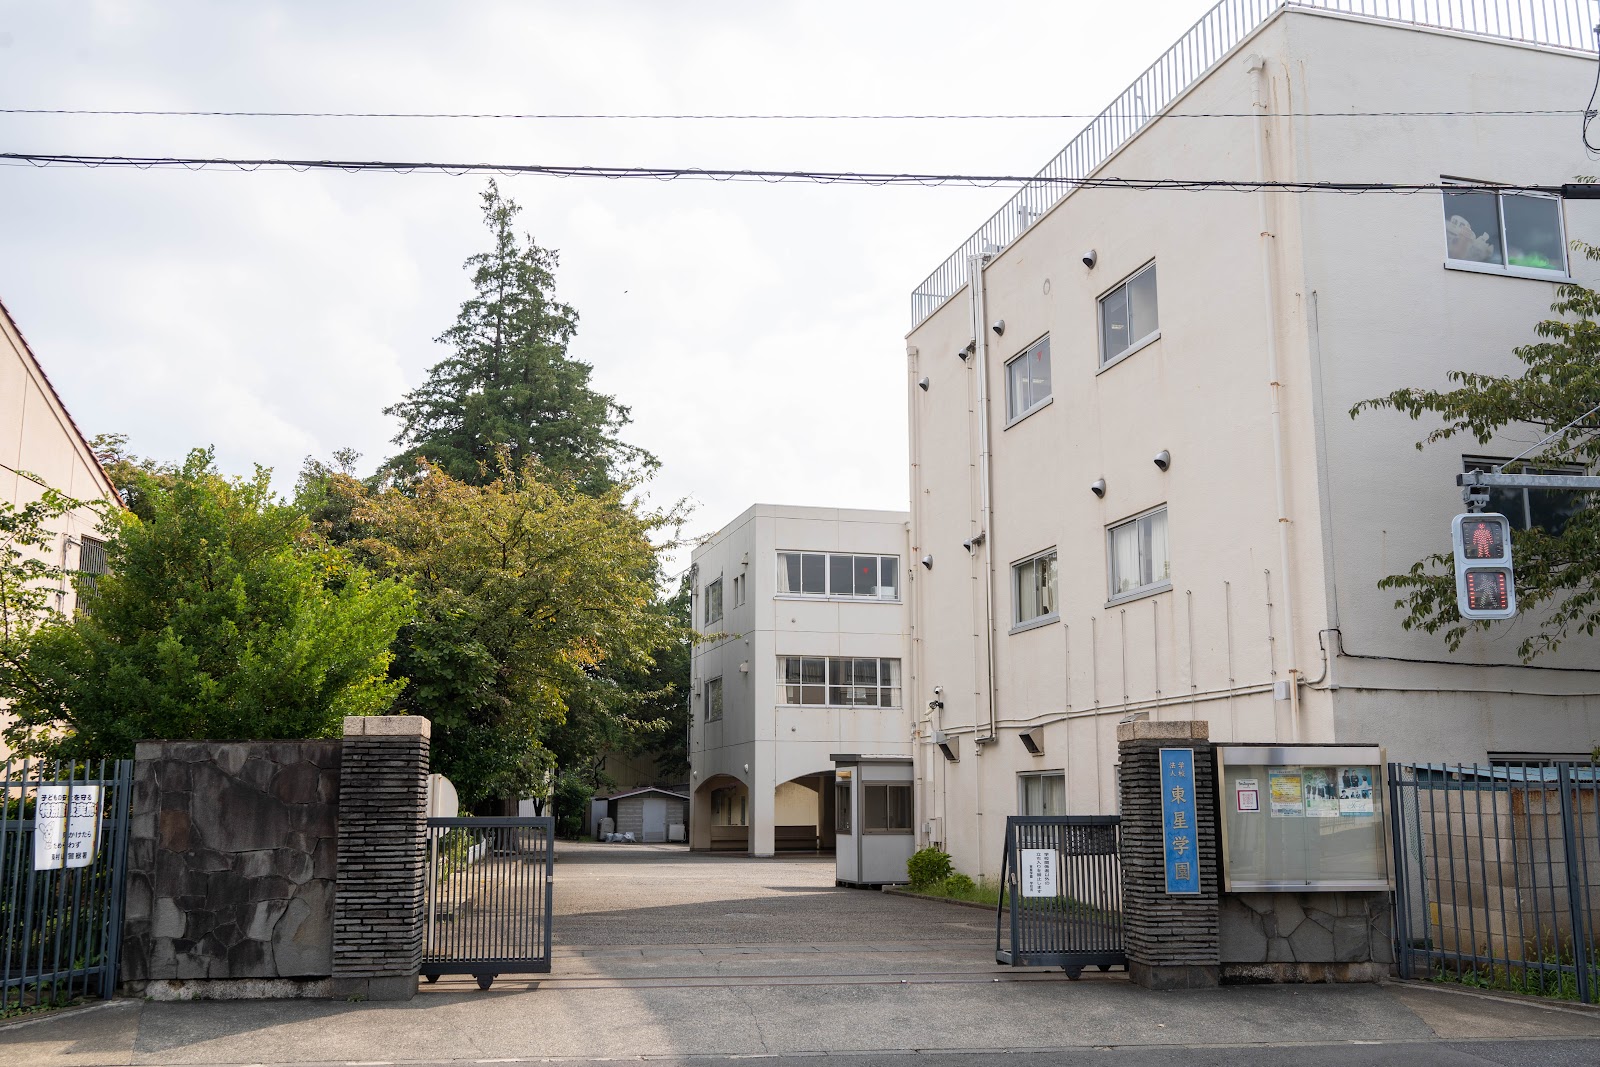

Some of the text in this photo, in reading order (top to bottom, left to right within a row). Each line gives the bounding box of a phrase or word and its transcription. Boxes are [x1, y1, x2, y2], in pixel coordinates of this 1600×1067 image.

[1169, 761, 1176, 778] 法人
[1178, 761, 1186, 778] 学校
[41, 794, 93, 802] 子どもの安を守る
[1171, 785, 1190, 881] 東星学園
[53, 841, 82, 850] ためわず
